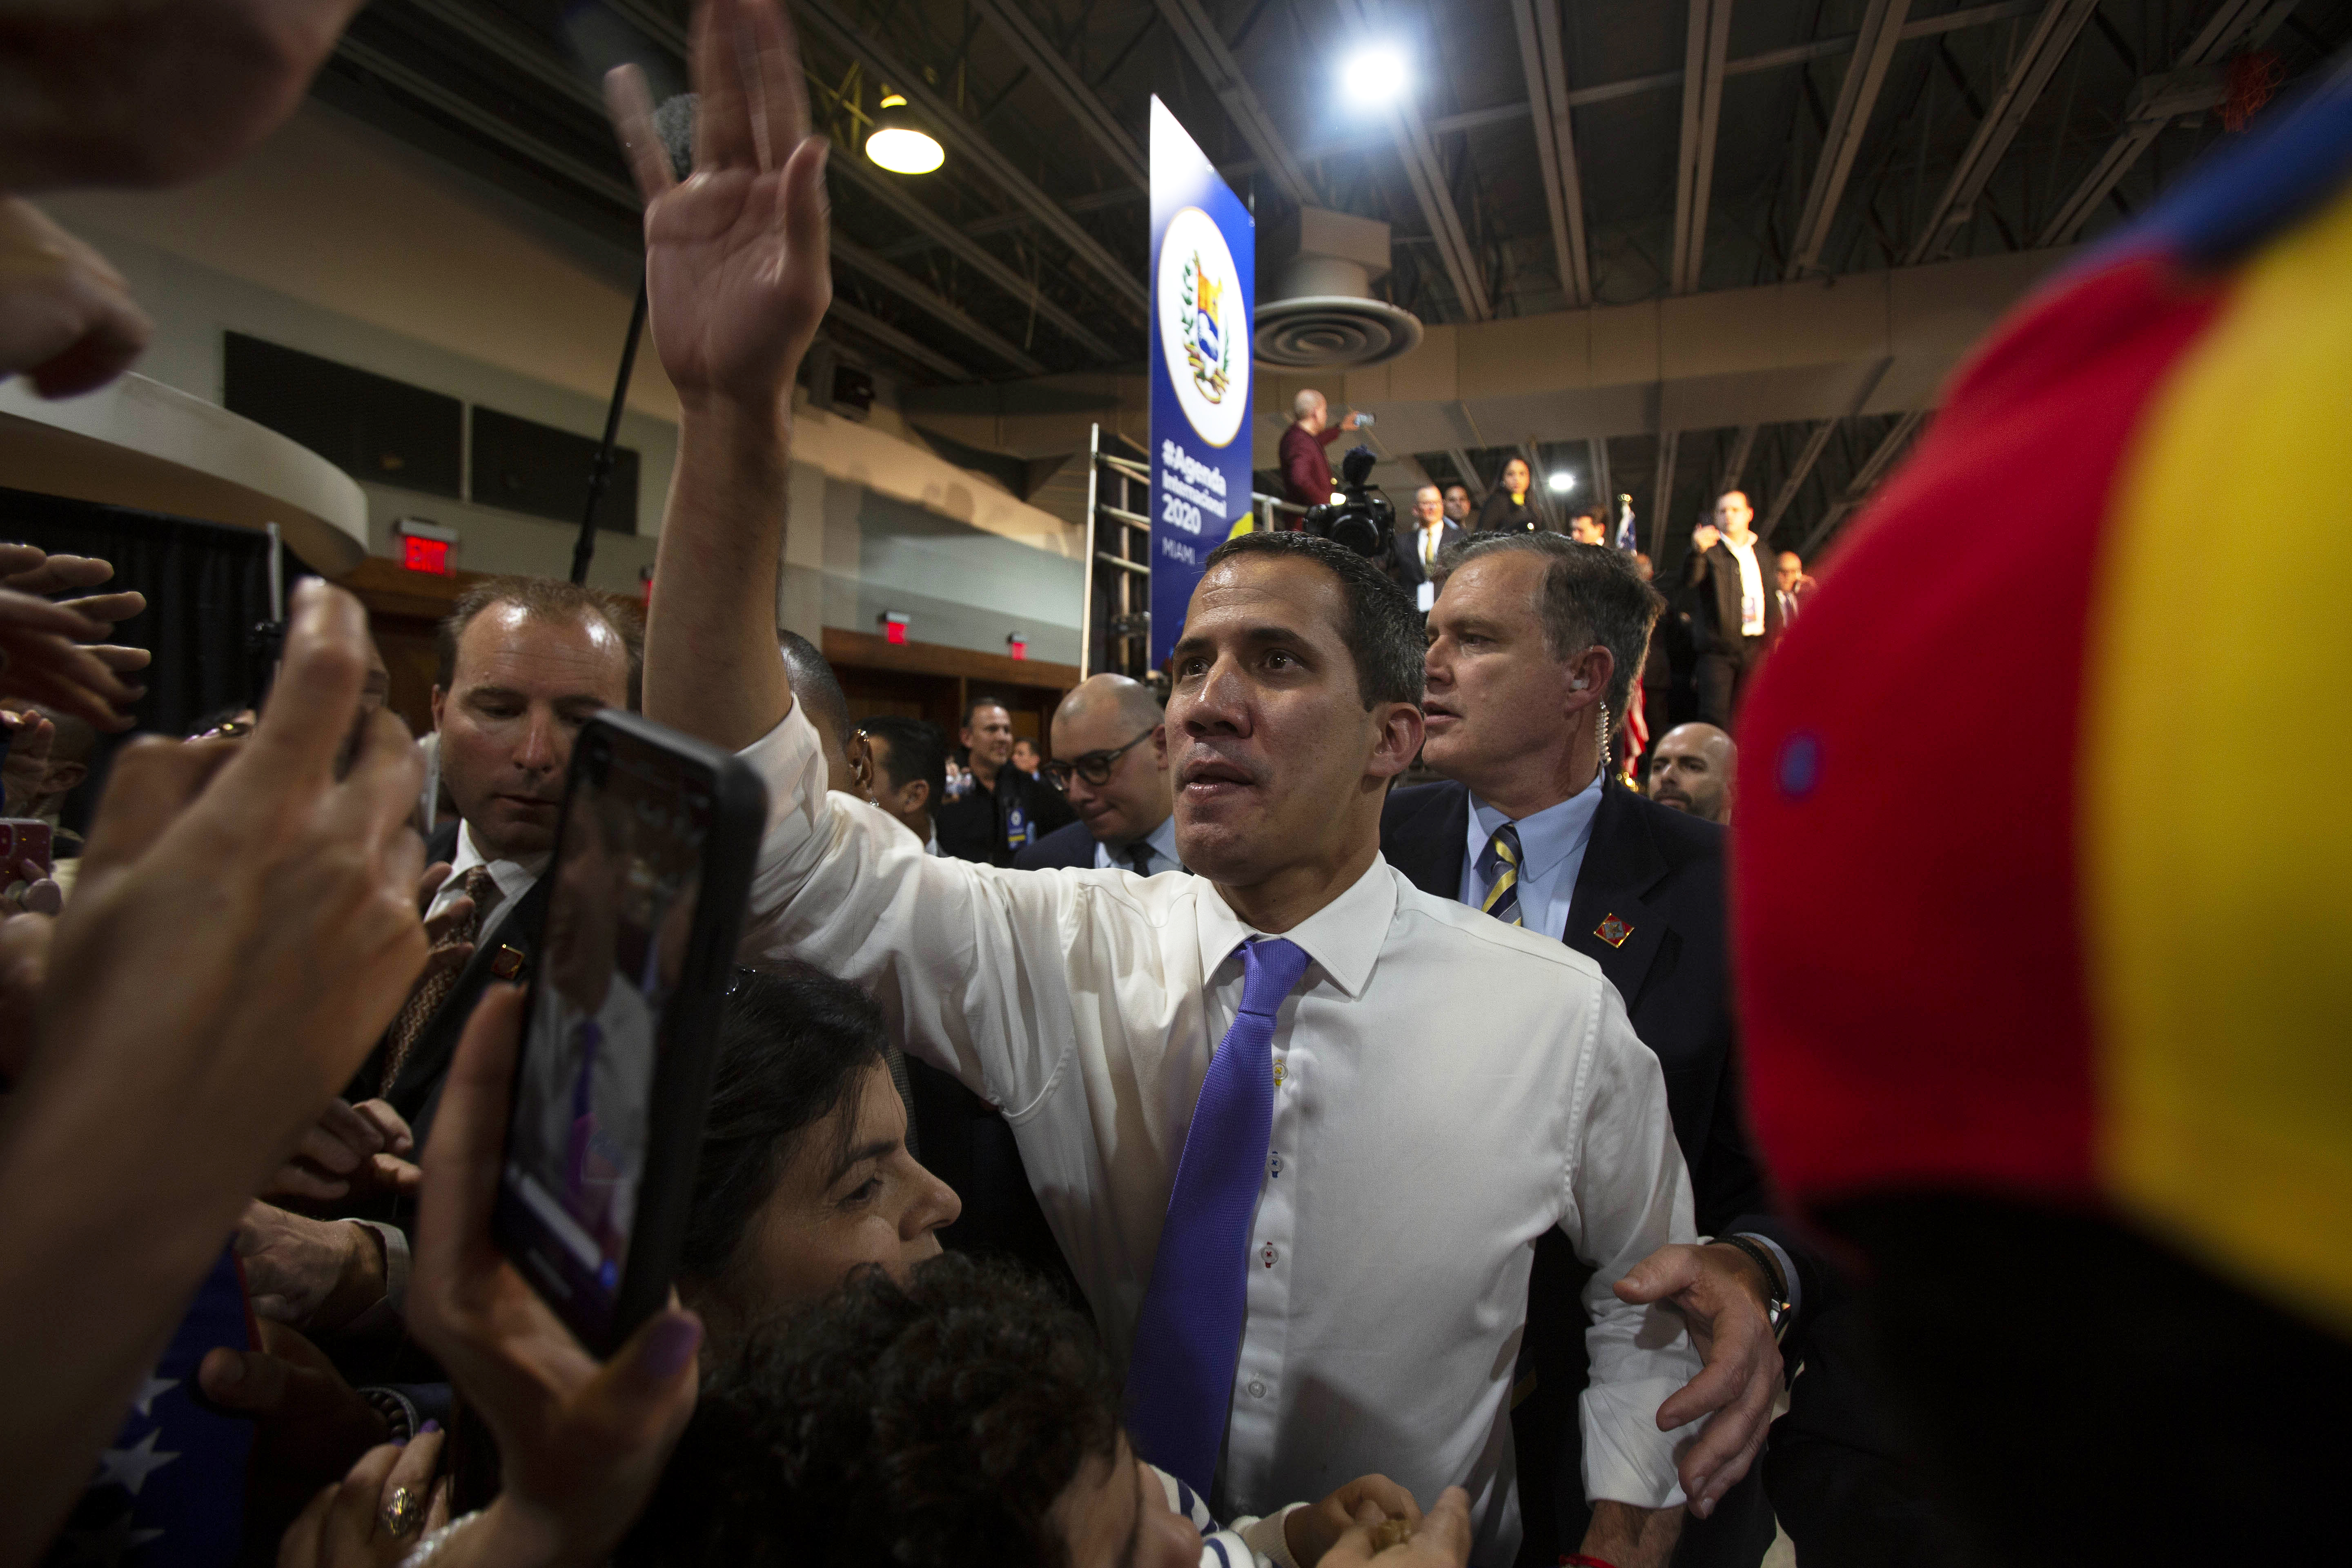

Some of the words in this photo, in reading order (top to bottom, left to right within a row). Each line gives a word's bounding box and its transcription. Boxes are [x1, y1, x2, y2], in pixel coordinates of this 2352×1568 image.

[1162, 439, 1227, 497] #Agenda
[1162, 493, 1202, 535] 2020
[1162, 536, 1196, 565] MIAMI
